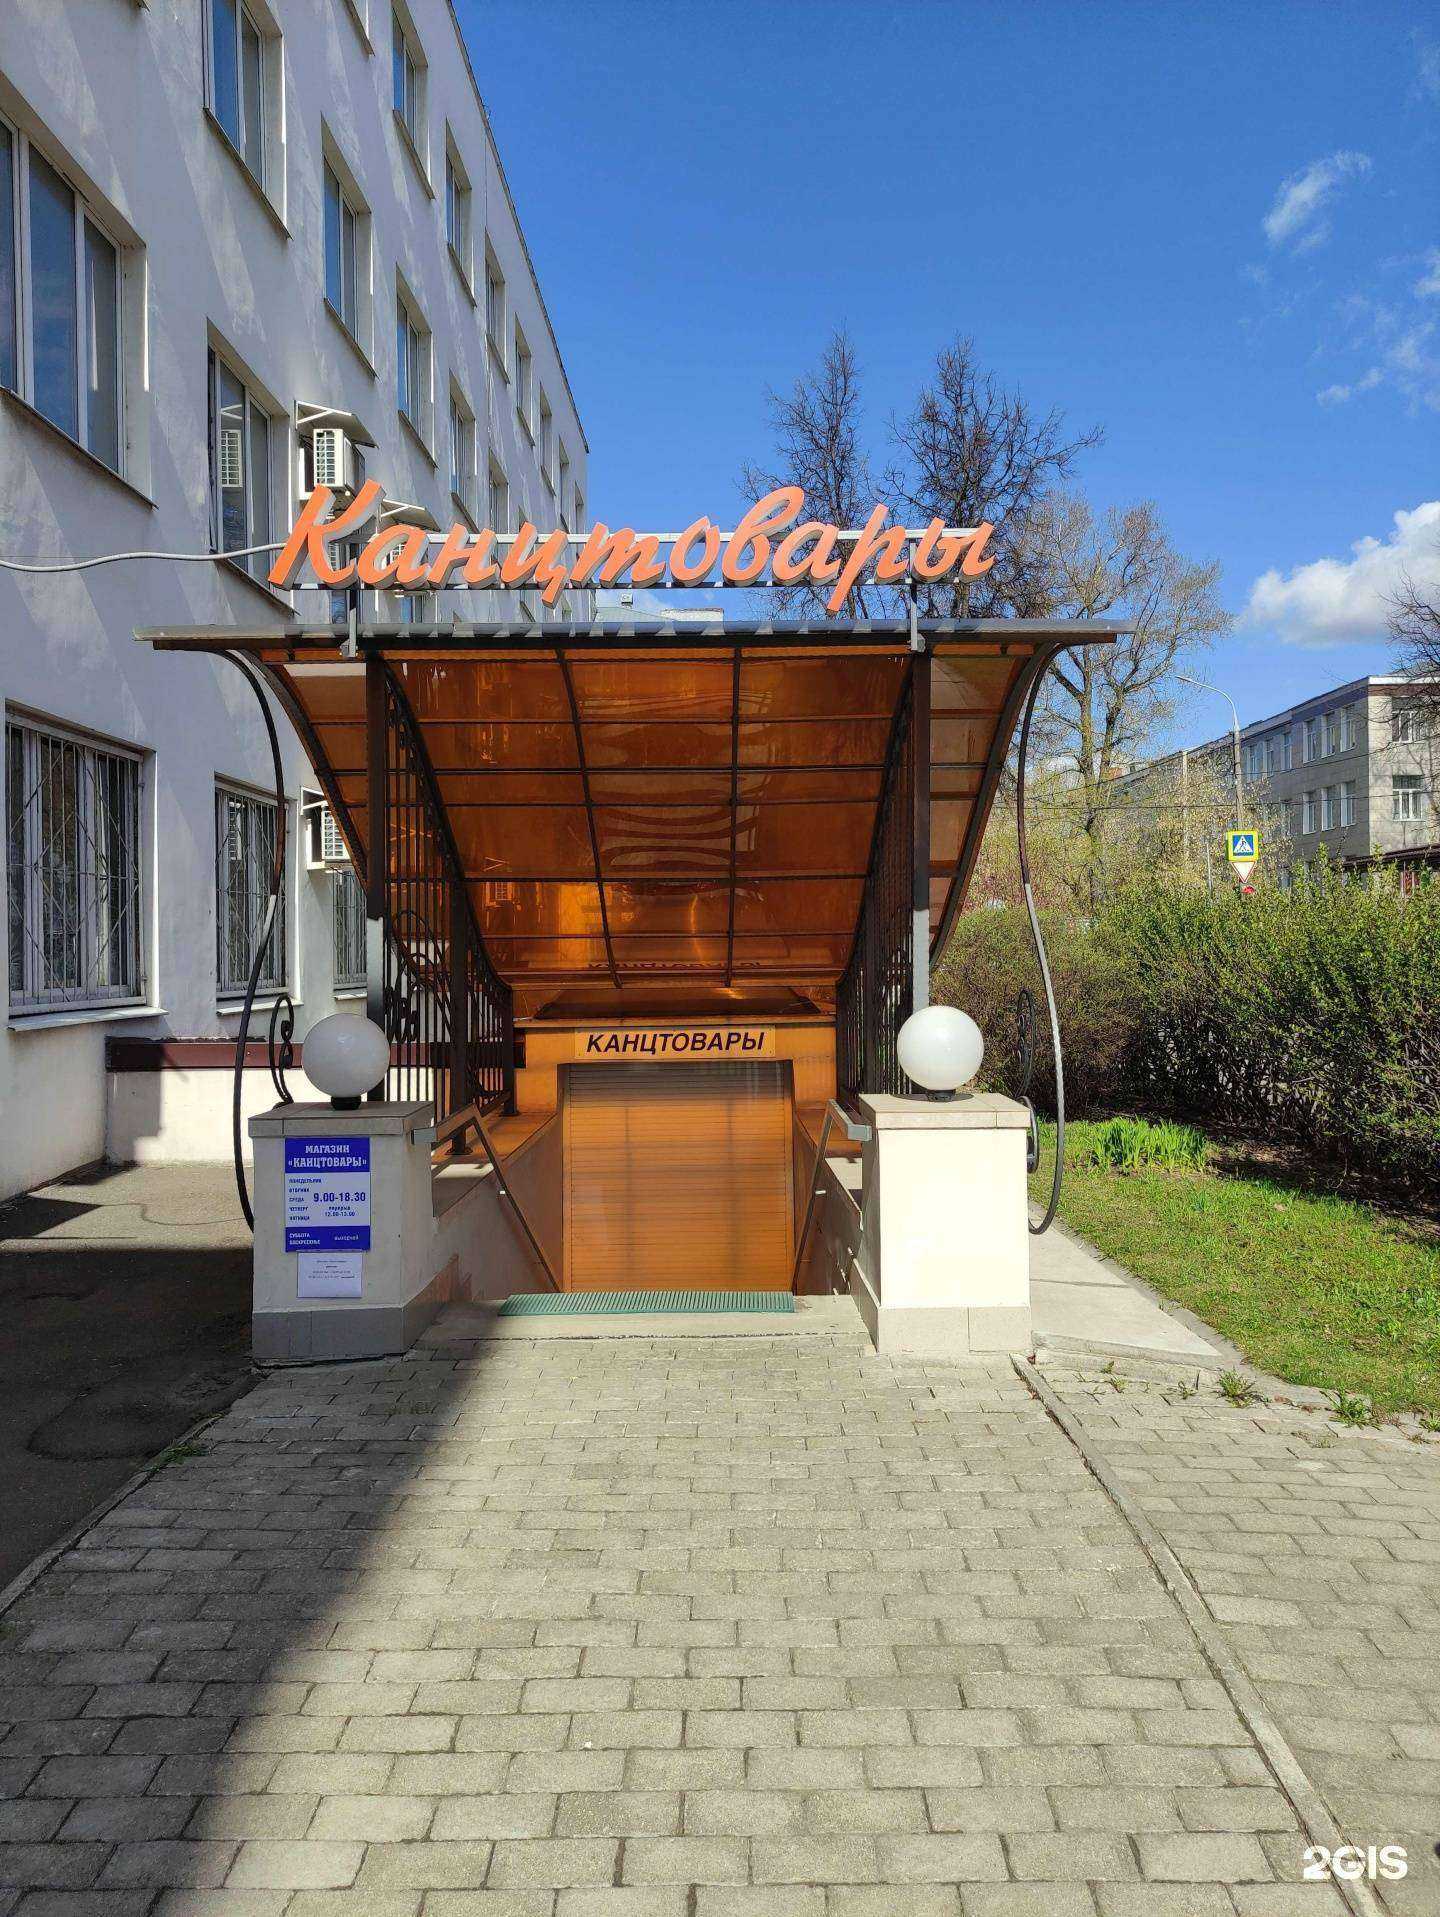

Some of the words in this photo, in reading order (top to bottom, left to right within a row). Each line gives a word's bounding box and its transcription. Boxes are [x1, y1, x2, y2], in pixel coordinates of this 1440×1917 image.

[268, 480, 998, 614] Канцтовары
[586, 1031, 765, 1055] КАНЦТОВАРЫ
[305, 1144, 350, 1154] МАГАЗИН
[313, 1192, 366, 1202] 9.00-18.30
